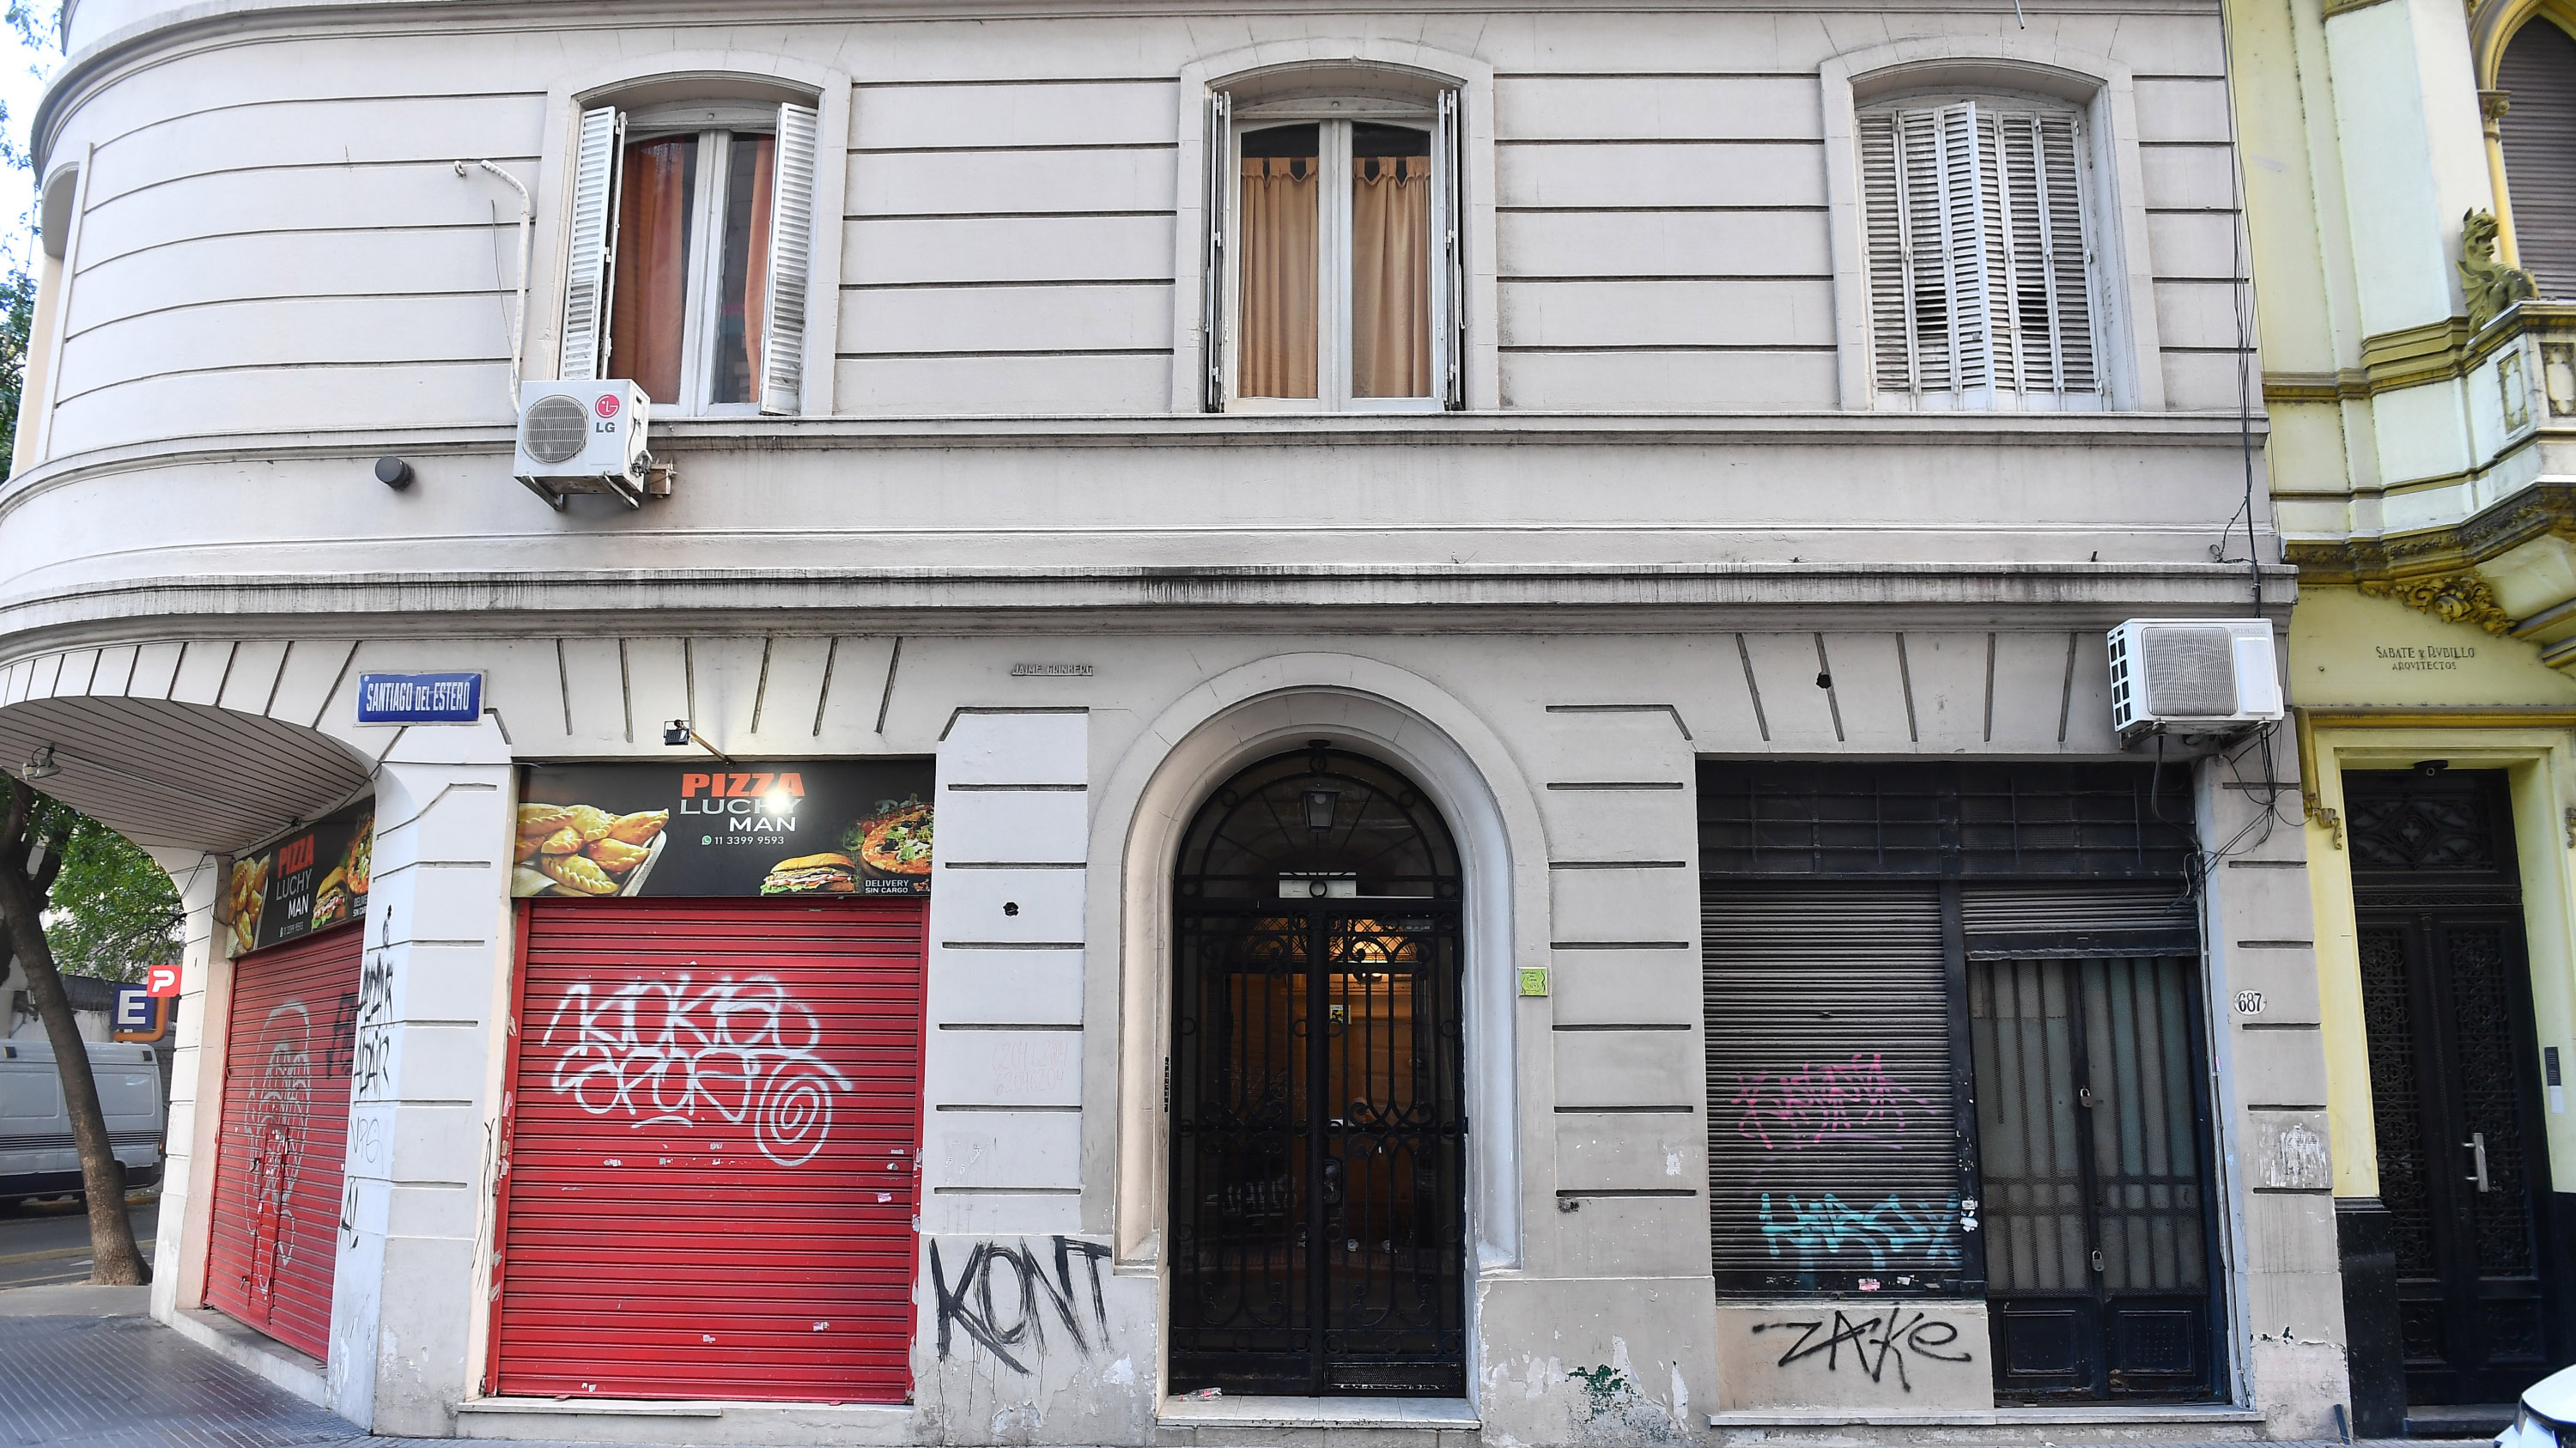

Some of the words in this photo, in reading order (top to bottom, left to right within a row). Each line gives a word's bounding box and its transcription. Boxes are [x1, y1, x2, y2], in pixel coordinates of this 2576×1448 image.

[595, 422, 616, 434] LG
[366, 683, 413, 712] SANTIAGO
[415, 686, 430, 711] DEL
[433, 681, 471, 711] ESTERO
[682, 772, 805, 798] PIZZA
[729, 817, 796, 832] MAN
[714, 837, 723, 845] 11
[726, 836, 754, 845] 3399
[757, 836, 785, 845] 9593
[277, 834, 314, 879] PIZZA
[276, 868, 313, 901] LUCHY
[288, 893, 309, 920] MAN
[151, 970, 176, 993] P
[117, 989, 147, 1025] E
[2239, 992, 2262, 1012] 687
[929, 1235, 1113, 1379] KONT
